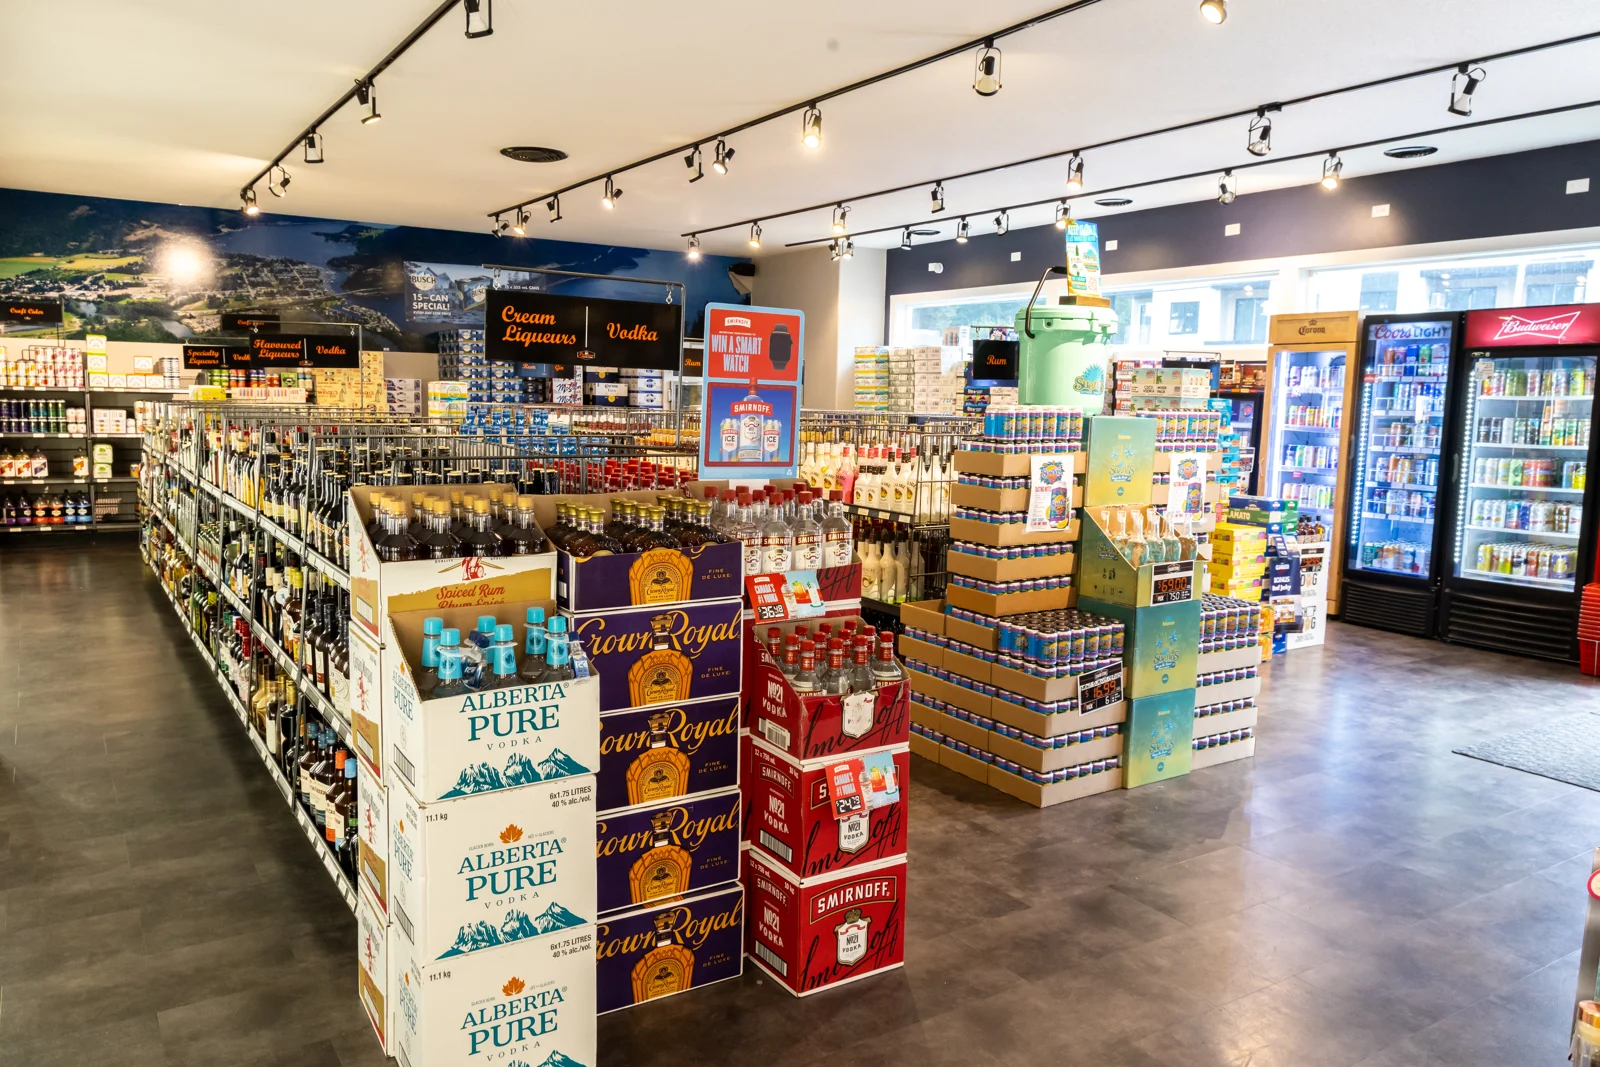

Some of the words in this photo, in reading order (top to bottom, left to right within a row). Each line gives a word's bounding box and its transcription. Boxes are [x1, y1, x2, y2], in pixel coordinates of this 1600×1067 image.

[411, 275, 437, 284] BUSCH
[10, 307, 27, 316] Craft
[28, 308, 44, 316] Cider
[412, 302, 450, 311] SPECIAL!
[501, 305, 557, 326] Cream
[606, 322, 659, 343] Vodka
[1298, 325, 1326, 336] Corona
[1374, 324, 1412, 340] Coors
[1414, 326, 1448, 338] LIGHT
[1505, 320, 1569, 334] Budweiser
[502, 324, 576, 348] Liqueurs
[253, 339, 302, 350] Flavoured
[316, 346, 347, 355] Vodka
[712, 334, 727, 353] WIN
[728, 335, 734, 354] A
[736, 336, 762, 355] SMART
[187, 349, 220, 358] Specialty
[258, 349, 300, 360] Liqueurs
[986, 354, 1008, 366] Rum
[188, 358, 220, 366] Liqueurs
[554, 364, 564, 372] Gin
[685, 358, 702, 368] Rum
[724, 354, 749, 372] WATCH
[734, 404, 771, 414] SMIRNOFF
[1273, 576, 1290, 584] BONUS
[436, 586, 476, 600] Spiced
[478, 584, 505, 596] Rum
[754, 584, 776, 594] CANADA'S
[1169, 592, 1180, 600] 750
[764, 594, 778, 604] VODKA
[665, 608, 742, 659] Royal
[393, 687, 414, 721] PURE
[458, 682, 566, 714] ALBERTA
[1104, 696, 1110, 704] 6
[762, 696, 788, 718] VODKA
[467, 704, 560, 742] PURE
[665, 703, 739, 756] Royal
[487, 735, 543, 751] VODKA
[762, 752, 770, 762] 750
[762, 766, 792, 792] SMIRNOFF
[833, 772, 854, 786] CANADA'S
[549, 791, 570, 800] 6x1.75
[570, 786, 592, 796] LITRES
[842, 783, 856, 796] VODKA
[551, 800, 560, 808] 40
[560, 799, 567, 807] %
[568, 794, 592, 806] alc./vol.
[426, 814, 439, 822] 11.1
[440, 812, 448, 821] kg
[764, 810, 790, 834] VODKA
[668, 799, 740, 853] Royal
[844, 832, 864, 841] VODKA
[394, 840, 413, 882] PURE
[457, 838, 564, 875] ALBERTA
[706, 855, 722, 863] FINE
[466, 860, 558, 902] PURE
[757, 878, 787, 906] SMIRNOFF
[818, 881, 889, 914] SMIRNOFF
[484, 892, 540, 910] VODKA
[670, 896, 743, 951] Royal
[550, 939, 571, 951] 6x1.75
[571, 934, 592, 946] LITRES
[758, 921, 784, 948] VODKA
[552, 950, 560, 959] 40
[561, 948, 568, 957] %
[568, 942, 592, 956] alc./vol.
[842, 944, 862, 954] VODKA
[429, 972, 443, 982] 11.1
[444, 970, 452, 979] kg
[399, 989, 416, 1036] PURE
[460, 987, 566, 1030] ALBERTA
[468, 1008, 559, 1056] PURE
[486, 1040, 541, 1062] VODKA
